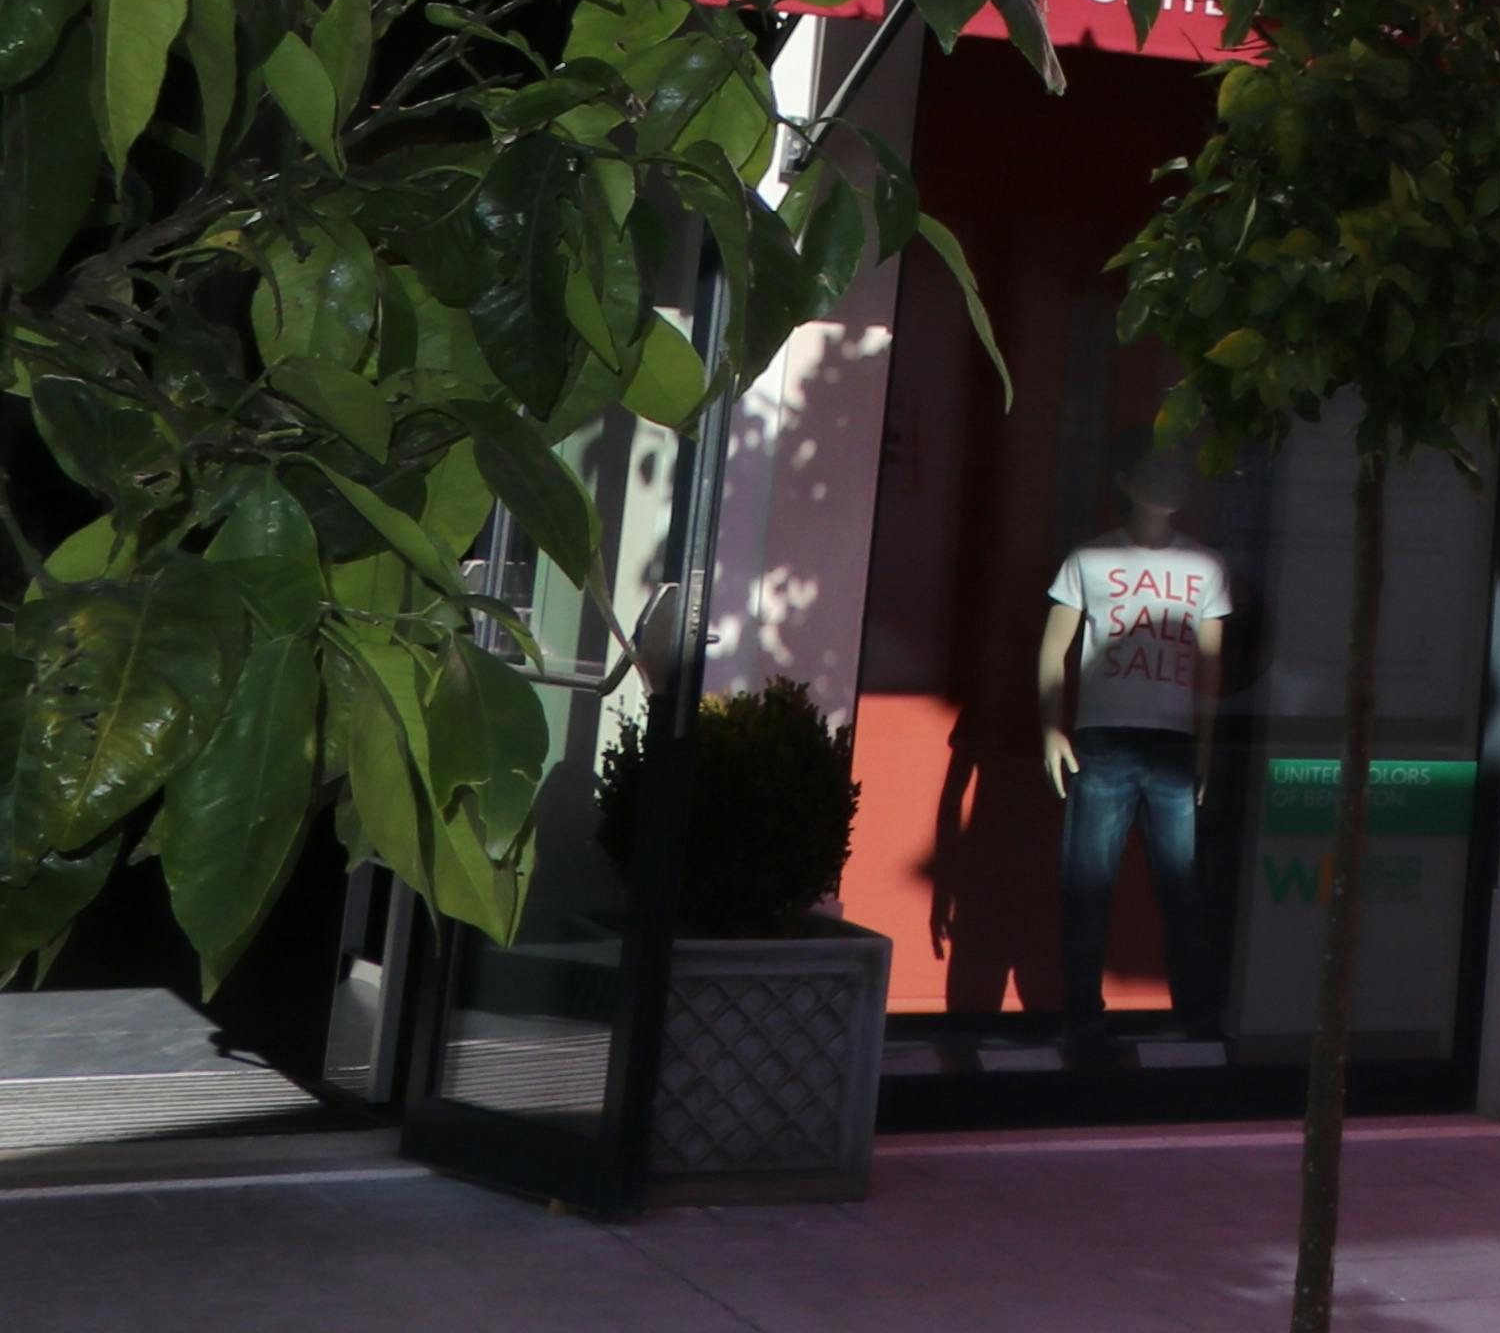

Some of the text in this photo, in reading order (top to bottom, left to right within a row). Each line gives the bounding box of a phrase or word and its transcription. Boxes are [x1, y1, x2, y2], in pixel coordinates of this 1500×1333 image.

[1108, 567, 1205, 606] SALE
[1108, 605, 1194, 647] SALE
[1103, 644, 1193, 687] SALE
